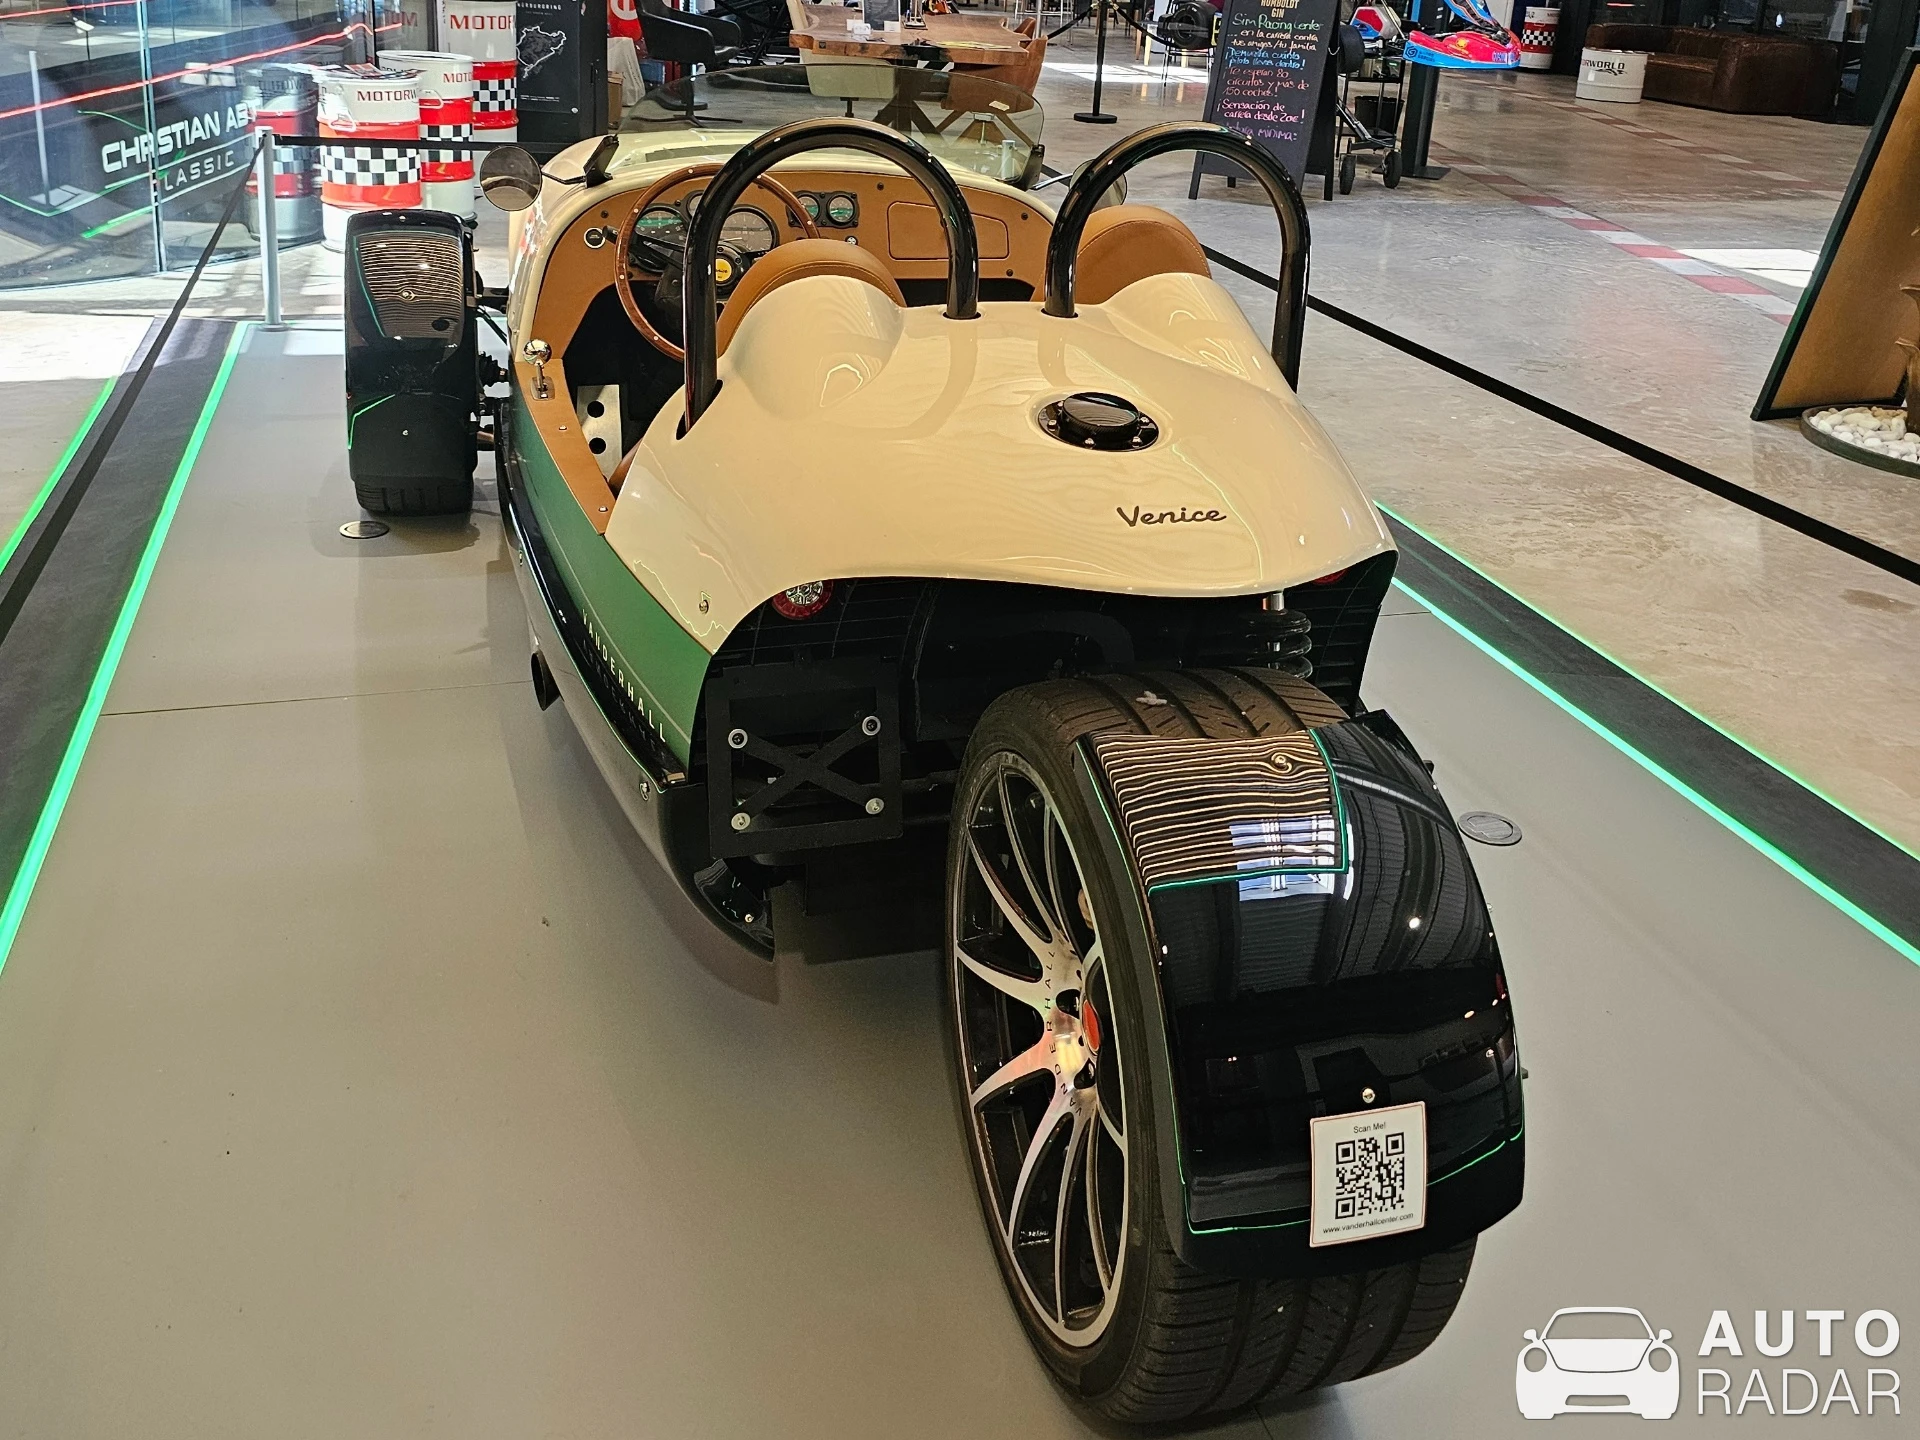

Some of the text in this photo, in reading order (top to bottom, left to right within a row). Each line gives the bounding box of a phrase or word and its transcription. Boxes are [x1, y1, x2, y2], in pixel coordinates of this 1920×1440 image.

[1232, 12, 1257, 27] Sim
[1258, 13, 1293, 33] Racing
[1271, 8, 1285, 18] GIN
[1241, 29, 1254, 37] en
[1256, 29, 1265, 38] la
[1253, 111, 1279, 122] desde
[1272, 102, 1286, 112] de
[102, 111, 221, 173] CHRSTIAN
[163, 150, 235, 191] LASSIC
[1116, 505, 1227, 527] Venice
[582, 608, 666, 743] VANDERHALL
[1044, 950, 1083, 1117] VANDERHALL
[1353, 1121, 1386, 1134] Scan Me!
[1322, 1212, 1414, 1234] www.vanderhallcenter.com
